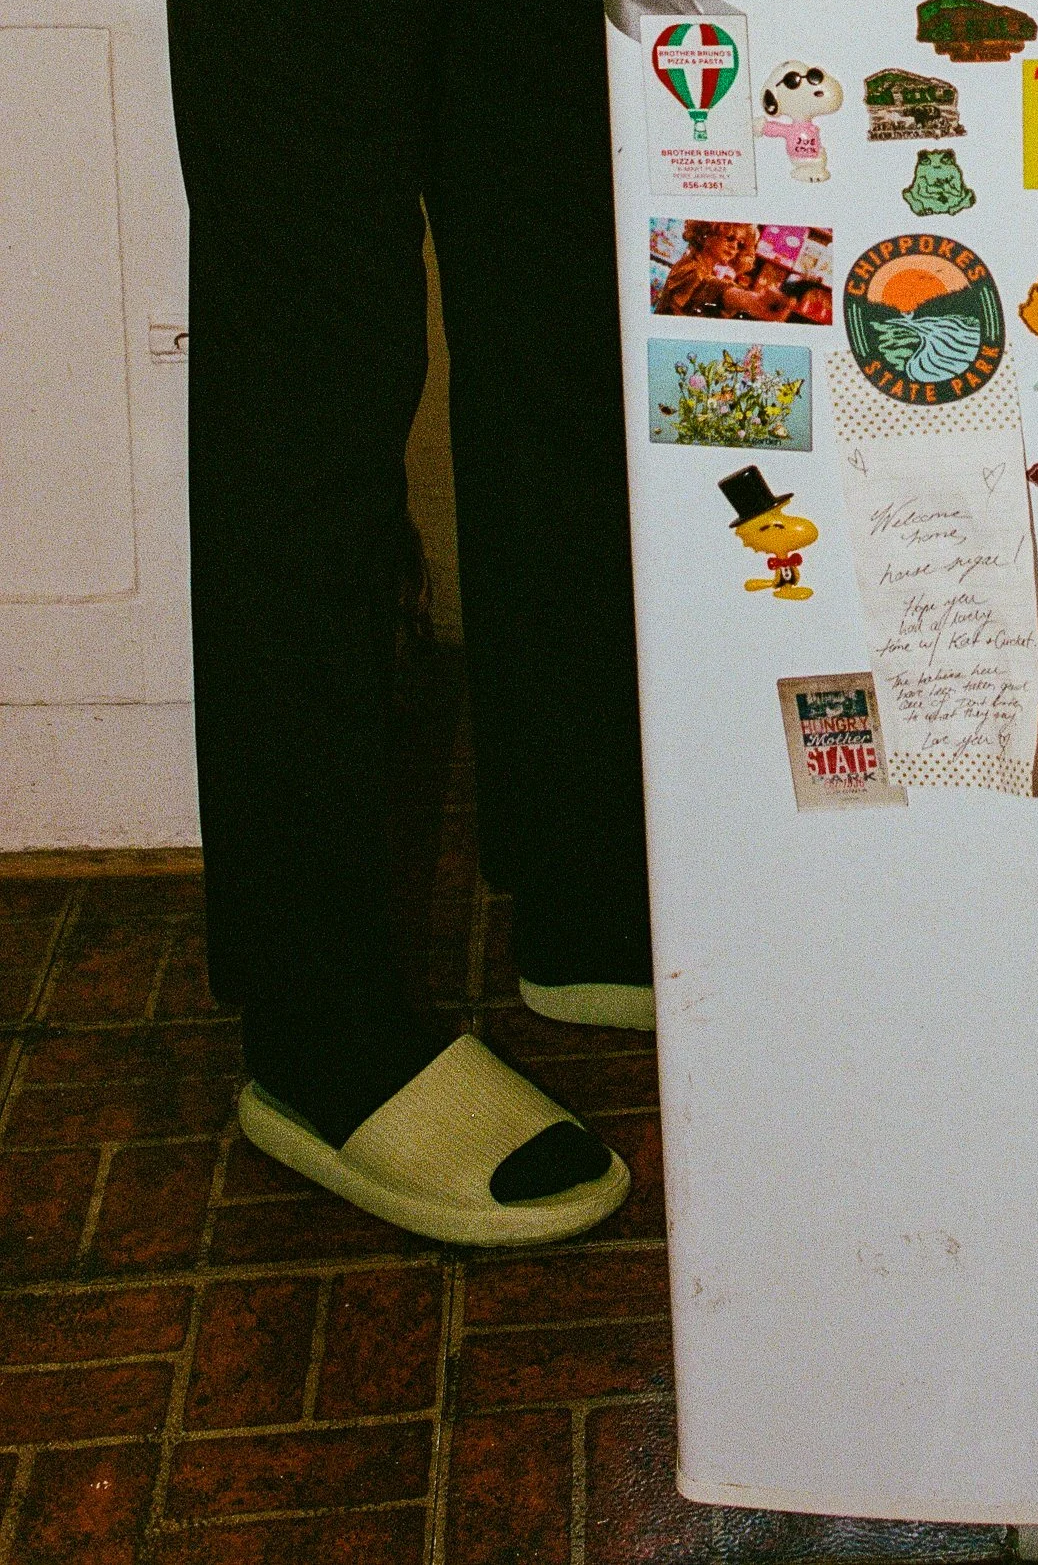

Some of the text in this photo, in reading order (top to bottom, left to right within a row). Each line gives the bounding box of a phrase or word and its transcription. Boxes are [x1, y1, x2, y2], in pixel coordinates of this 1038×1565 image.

[661, 149, 742, 157] BROTHER BRUNO'S
[847, 236, 987, 296] CHIPPOKES
[864, 345, 1000, 403] STATE PARK
[871, 497, 973, 535] Welcome
[801, 717, 869, 733] HUNGRY
[806, 731, 870, 746] Mother
[806, 746, 878, 776] STATE
